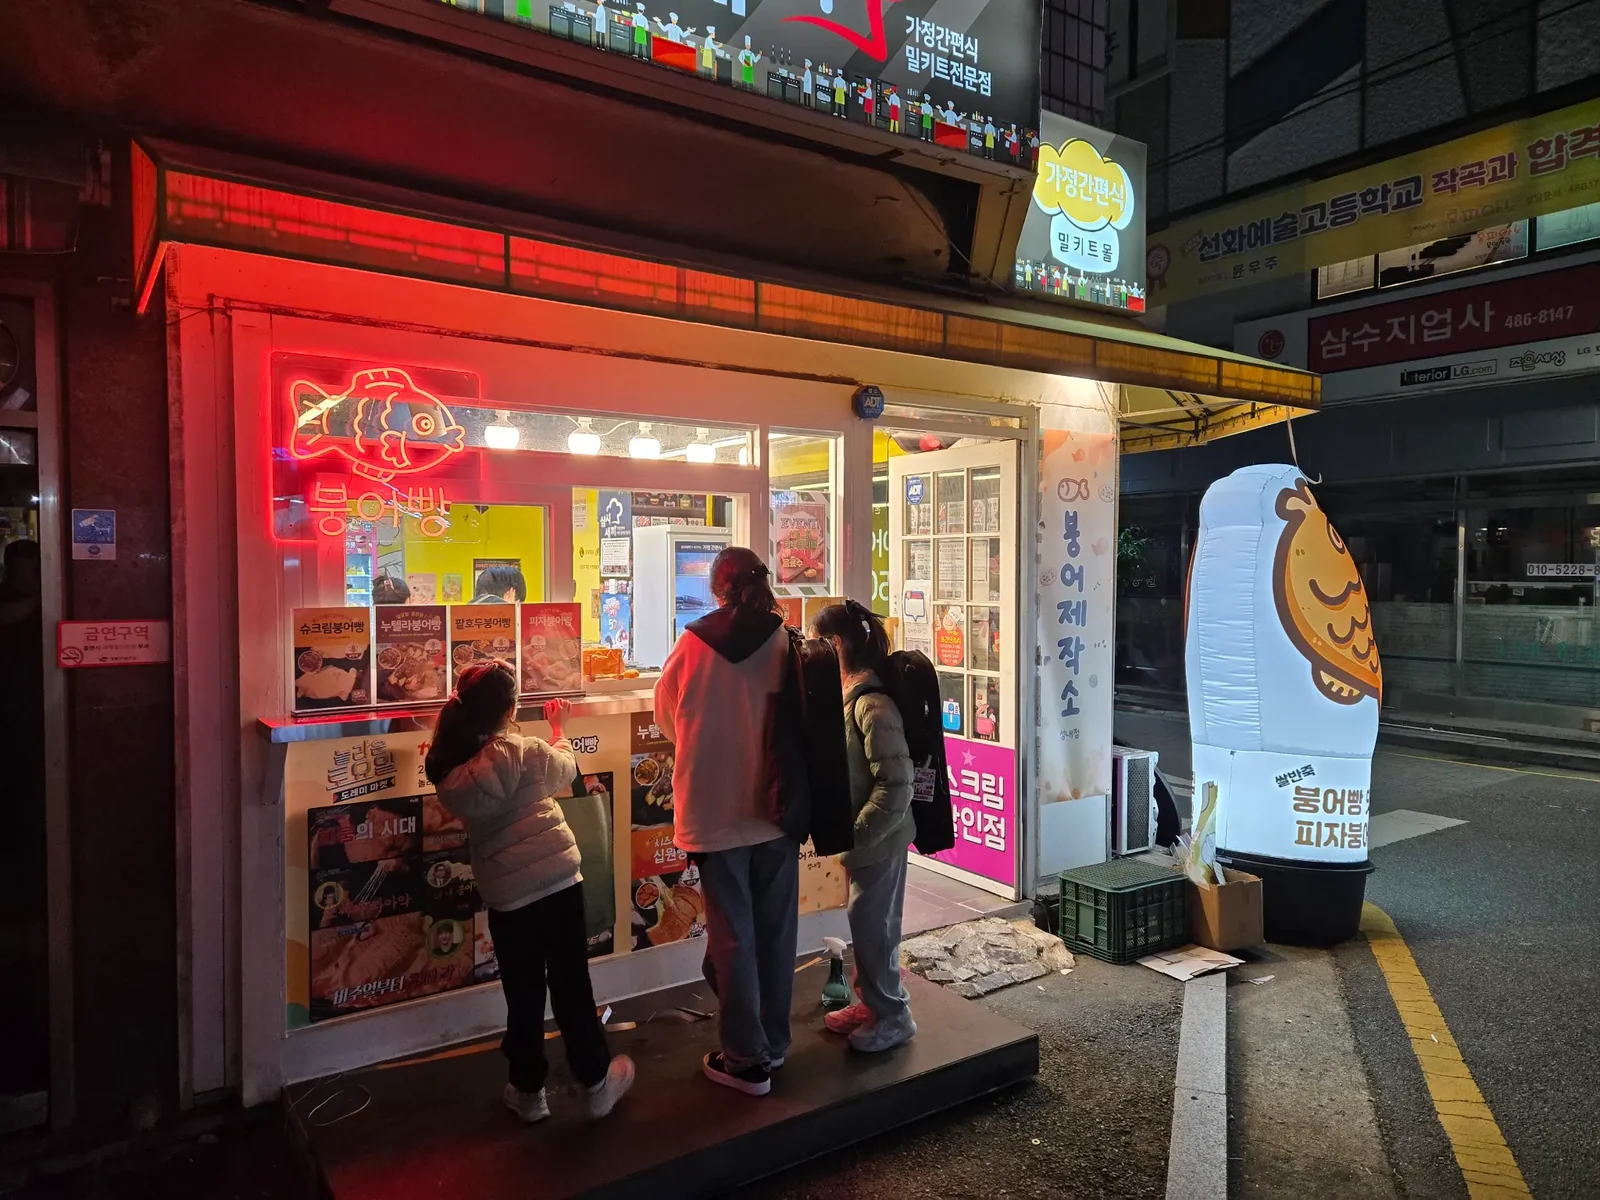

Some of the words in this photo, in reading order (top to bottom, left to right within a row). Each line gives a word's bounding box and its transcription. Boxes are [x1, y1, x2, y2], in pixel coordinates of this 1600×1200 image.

[905, 15, 978, 63] 가정간편식
[905, 45, 992, 97] 밀키트전문점
[1045, 161, 1125, 211] 가정간편식
[1197, 175, 1424, 262] 선화예술고등학교
[1432, 151, 1518, 196] 작곡과
[1320, 300, 1497, 360] 삼수지업사
[1504, 305, 1576, 329] 486-8147
[864, 396, 881, 408] ADT
[908, 484, 922, 496] ADT
[310, 482, 452, 536] 붕어빵
[299, 621, 366, 635] 슈크림붕어빵
[380, 618, 442, 632] 누텔라붕어빵
[455, 617, 511, 629] 팥호두붕어빵
[528, 614, 573, 627] 피자붕어빵
[84, 625, 149, 641] 금연구역
[636, 723, 663, 740] 누텔
[568, 735, 599, 753] 어빵
[1274, 764, 1317, 788] 쌀반죽
[340, 784, 369, 800] 도레미
[369, 779, 389, 793] 마켓
[1293, 785, 1364, 816] 붕어빵
[381, 816, 416, 837] 시대
